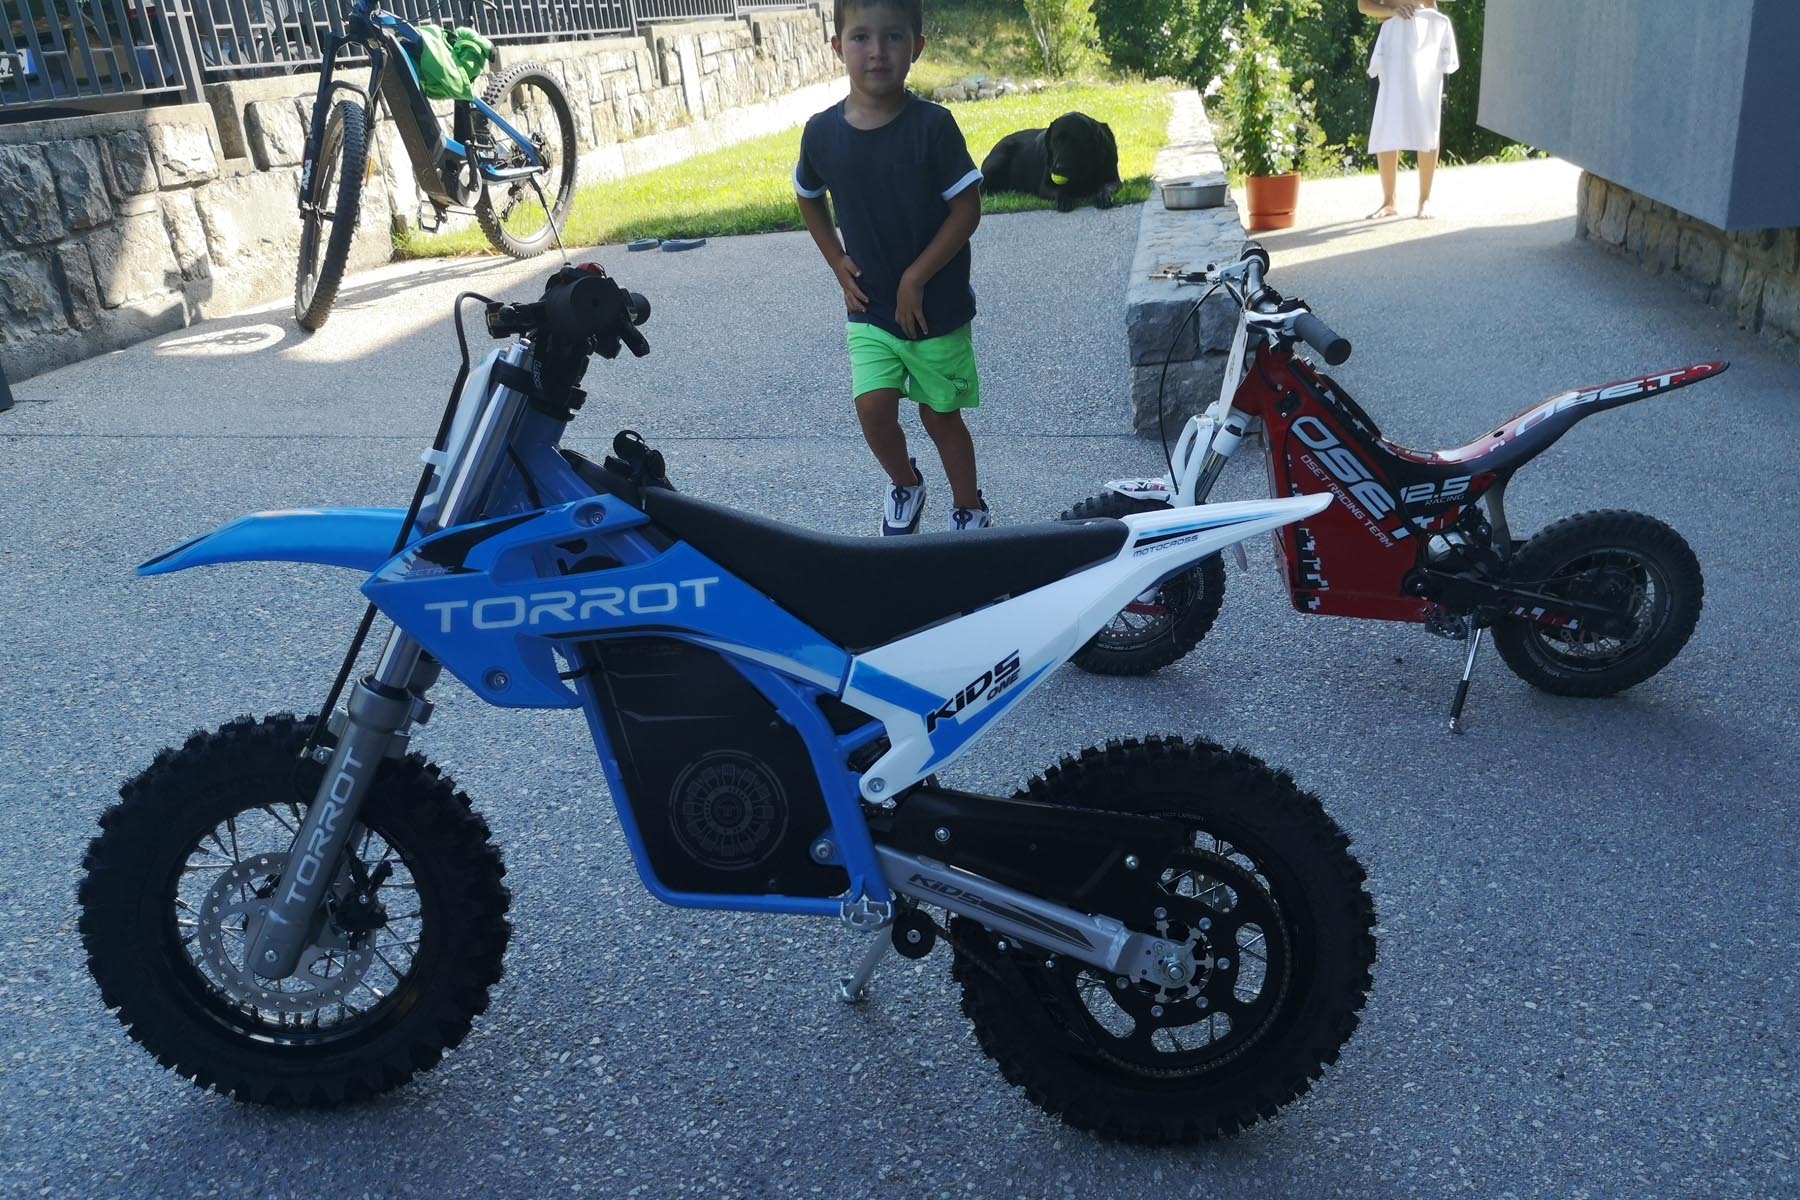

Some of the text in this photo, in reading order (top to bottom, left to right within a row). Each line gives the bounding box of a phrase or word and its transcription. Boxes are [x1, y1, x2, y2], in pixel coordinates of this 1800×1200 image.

[1515, 370, 1686, 437] OSET
[1291, 416, 1410, 541] OSE
[1300, 453, 1395, 548] OSET RACING TEAM
[1424, 493, 1465, 507] RACING
[1132, 534, 1199, 557] MOTOCROSS
[424, 576, 720, 633] TORROT
[987, 671, 1020, 701] ONE
[284, 746, 364, 906] TORROT
[908, 873, 985, 905] KIDS
